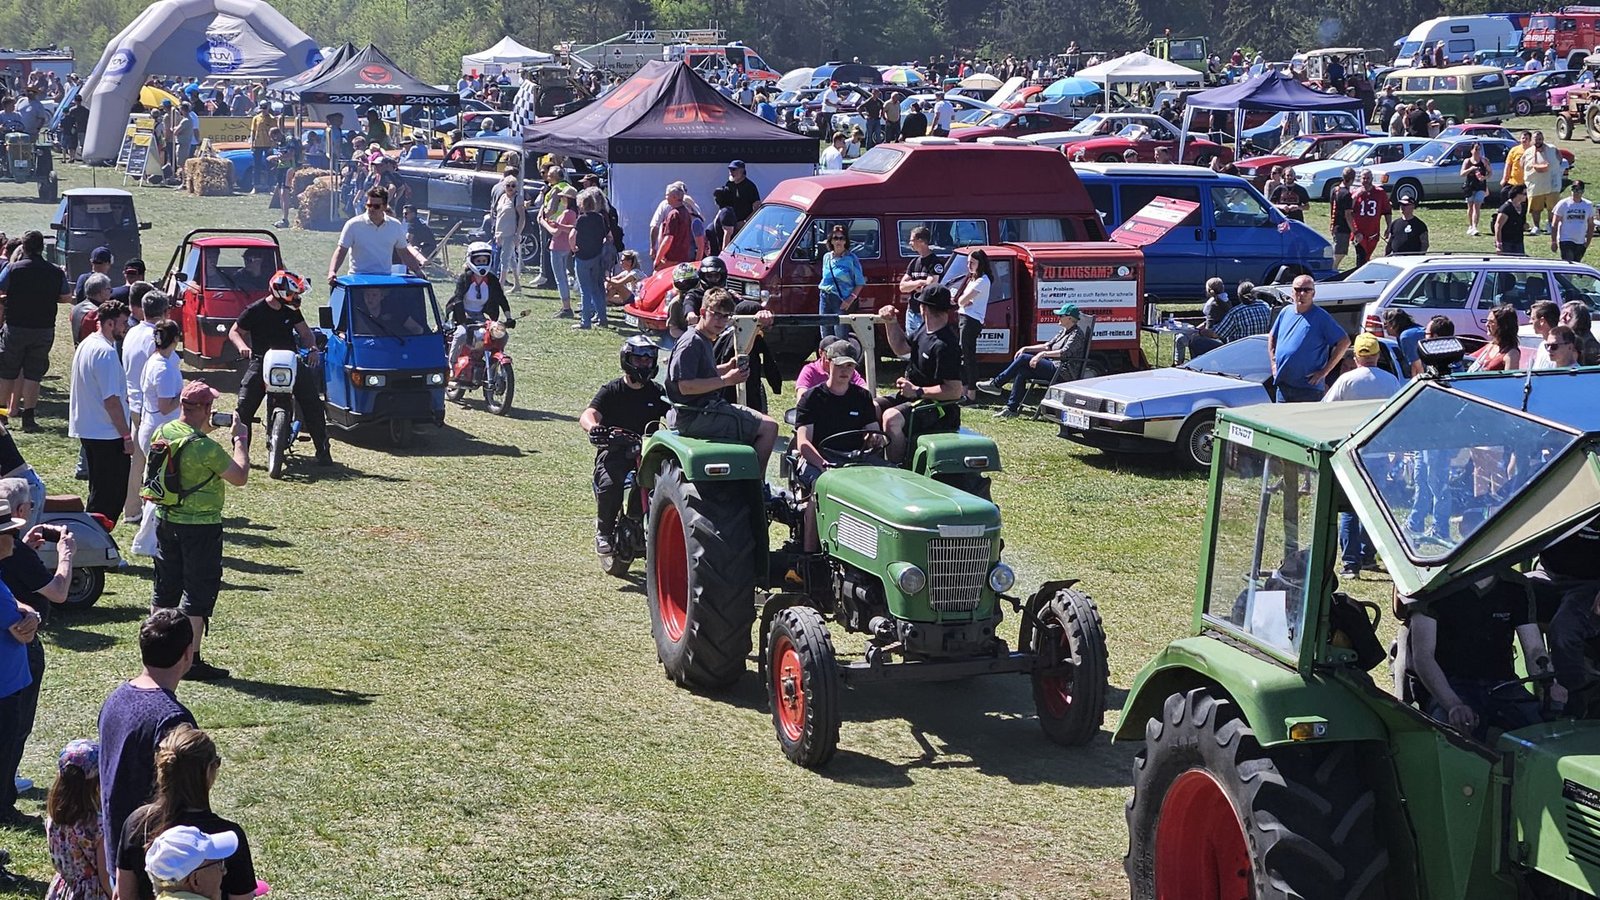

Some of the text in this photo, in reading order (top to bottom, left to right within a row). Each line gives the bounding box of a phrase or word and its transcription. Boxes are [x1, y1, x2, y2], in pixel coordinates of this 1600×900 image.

[329, 95, 373, 104] 24MX
[406, 95, 449, 105] 24MX
[615, 145, 687, 155] OLDTIMER
[692, 145, 718, 155] ERZ
[1359, 200, 1377, 217] 13
[1043, 265, 1114, 279] ZU LANGSAM?
[1231, 425, 1252, 439] FENDT
